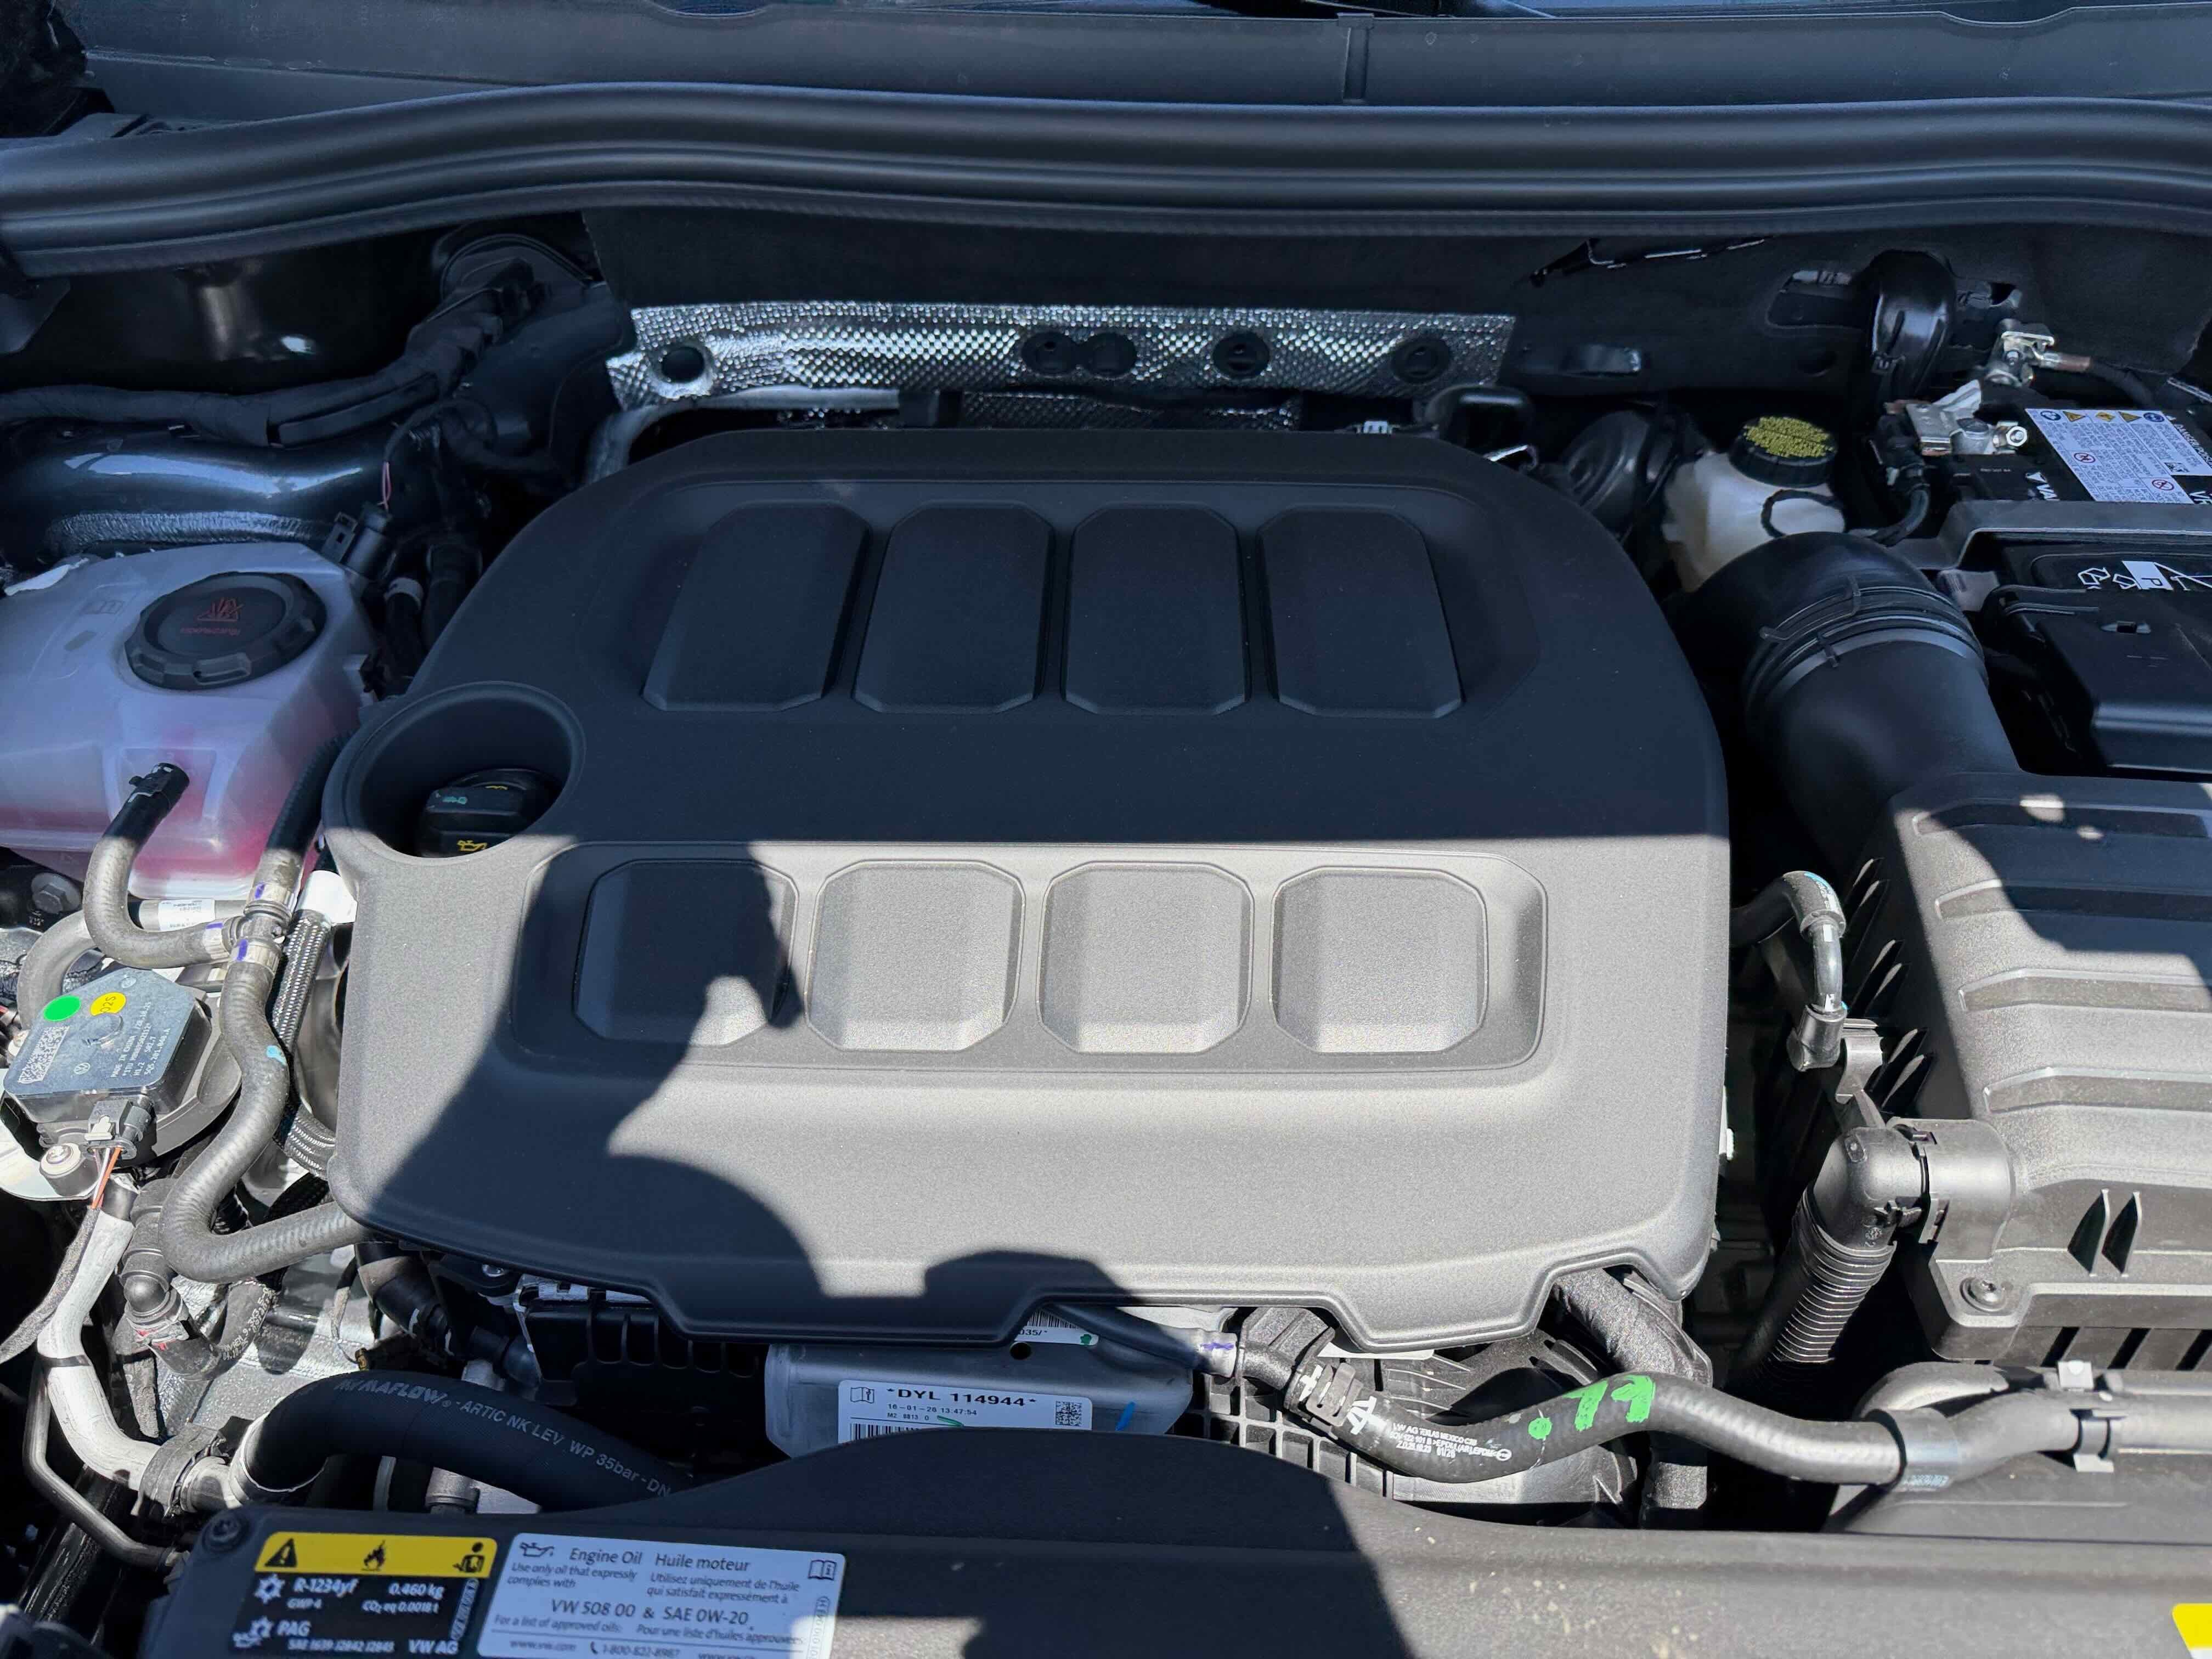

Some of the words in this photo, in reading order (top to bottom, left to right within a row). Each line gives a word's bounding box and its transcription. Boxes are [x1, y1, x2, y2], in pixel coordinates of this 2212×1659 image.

[941, 1407, 977, 1416] 13:47:54
[460, 1400, 506, 1423] ARTIC
[506, 1414, 532, 1433] NK
[532, 1424, 565, 1446] LEV
[569, 1439, 595, 1458] WP
[596, 1453, 640, 1482] 35bar
[1406, 1426, 1418, 1435] AG
[1440, 1431, 1464, 1444] MEXICO
[569, 1547, 618, 1565] Engine
[622, 1551, 643, 1564] Oil
[654, 1553, 693, 1569] Huile
[695, 1558, 751, 1572] moteur
[511, 1562, 531, 1572] Use
[532, 1564, 552, 1575] only
[554, 1565, 568, 1574] oil
[569, 1565, 589, 1576] that
[591, 1568, 637, 1581] expressly
[293, 1578, 360, 1598] R-1234yf
[388, 1583, 426, 1596] 0.460
[427, 1584, 445, 1600] kg
[506, 1575, 550, 1589] complies
[553, 1577, 576, 1588] with
[650, 1572, 689, 1585] Utilisez
[689, 1576, 752, 1590] uniquement
[754, 1578, 767, 1589] de
[647, 1586, 664, 1599] qui
[665, 1586, 706, 1599] satisfait
[707, 1590, 780, 1605] expressément
[551, 1599, 579, 1614] VW
[581, 1601, 611, 1616] 508
[614, 1602, 636, 1618] 00
[642, 1606, 654, 1619] &
[663, 1606, 693, 1622] SAE
[695, 1608, 749, 1626] 0W-20
[277, 1620, 311, 1637] PAG
[495, 1613, 510, 1626] For
[521, 1615, 537, 1627] list
[538, 1616, 551, 1628] of
[551, 1618, 600, 1633] approved
[636, 1623, 660, 1636] Pour
[662, 1627, 681, 1637] une
[682, 1627, 704, 1639] liste
[408, 1639, 435, 1653] VW
[435, 1640, 459, 1654] AG
